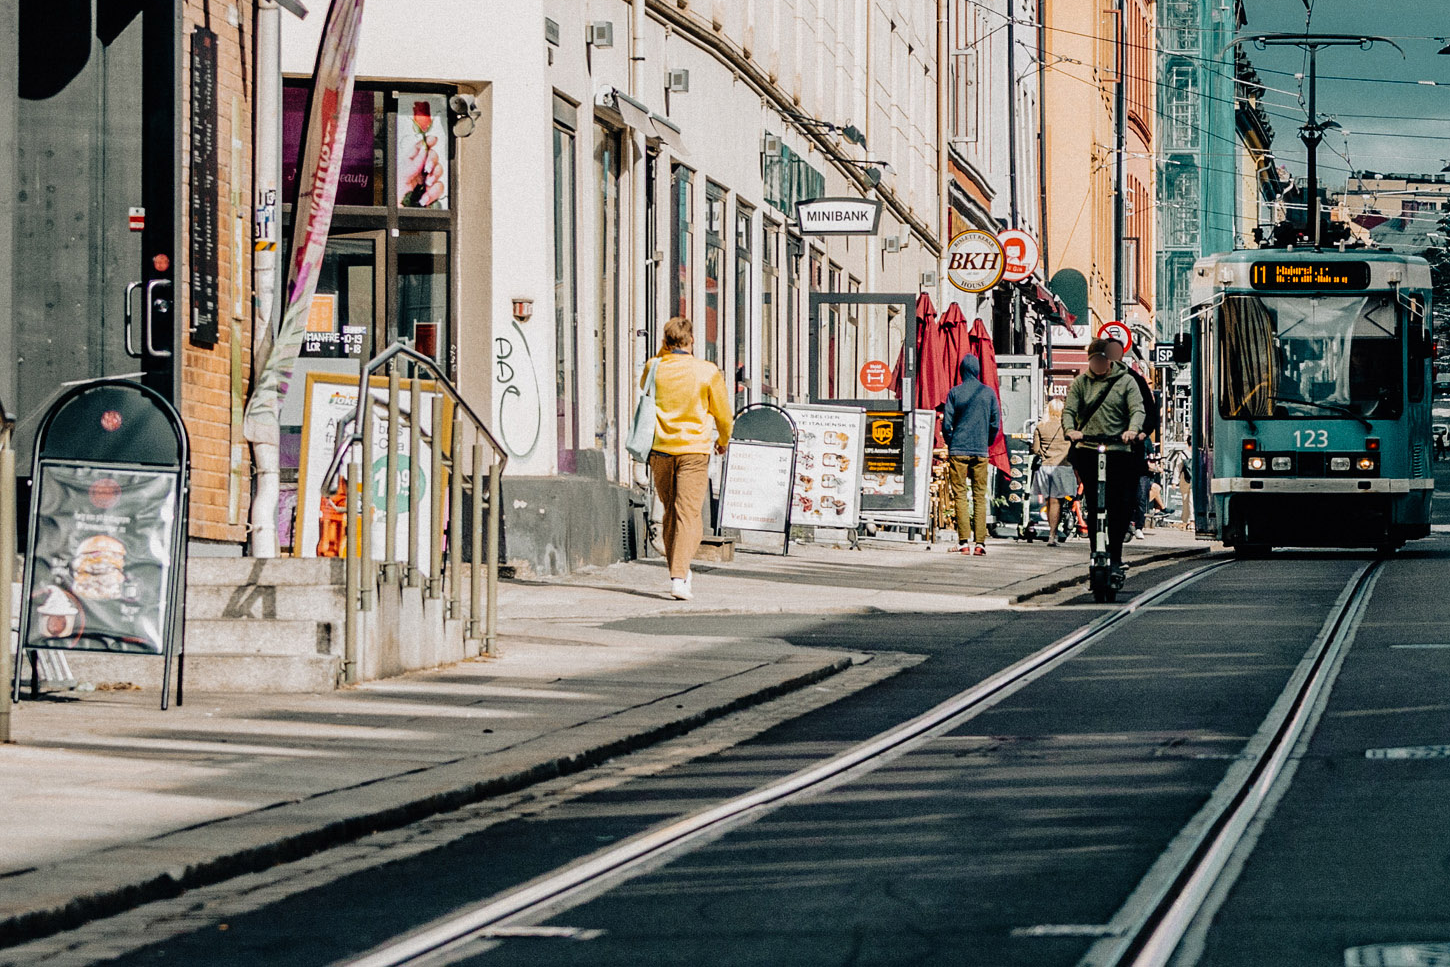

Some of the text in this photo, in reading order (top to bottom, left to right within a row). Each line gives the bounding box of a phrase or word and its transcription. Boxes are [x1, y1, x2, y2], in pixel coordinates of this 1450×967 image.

[339, 173, 369, 188] eauty
[806, 210, 869, 222] MINIBANK
[953, 234, 976, 248] BISLETT
[948, 252, 1001, 270] BKH
[961, 280, 986, 289] HOUSE
[329, 392, 358, 406] joke
[874, 428, 892, 441] ups
[1293, 429, 1329, 448] 123
